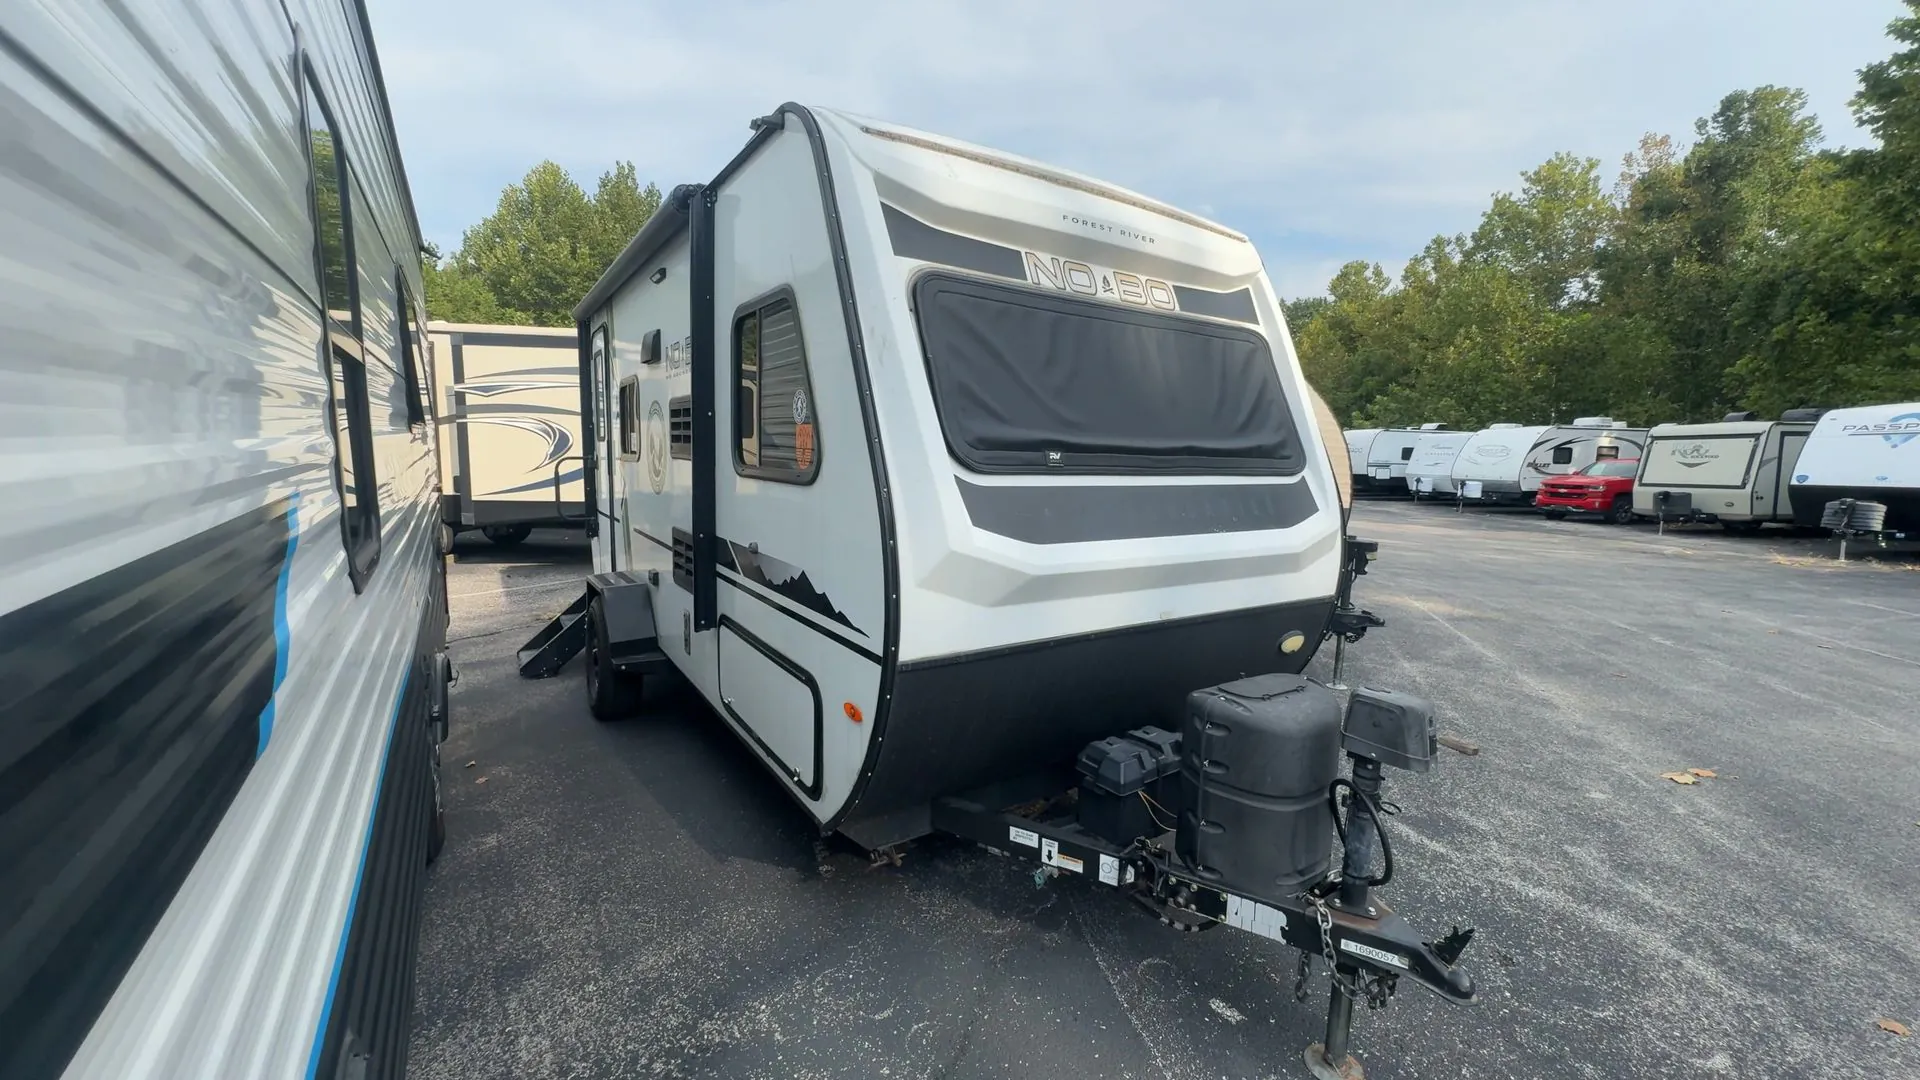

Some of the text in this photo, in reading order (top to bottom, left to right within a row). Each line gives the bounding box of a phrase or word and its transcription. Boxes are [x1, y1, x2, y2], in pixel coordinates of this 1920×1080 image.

[1062, 214, 1155, 244] FOREST RIVER
[1354, 945, 1396, 963] 1690057
